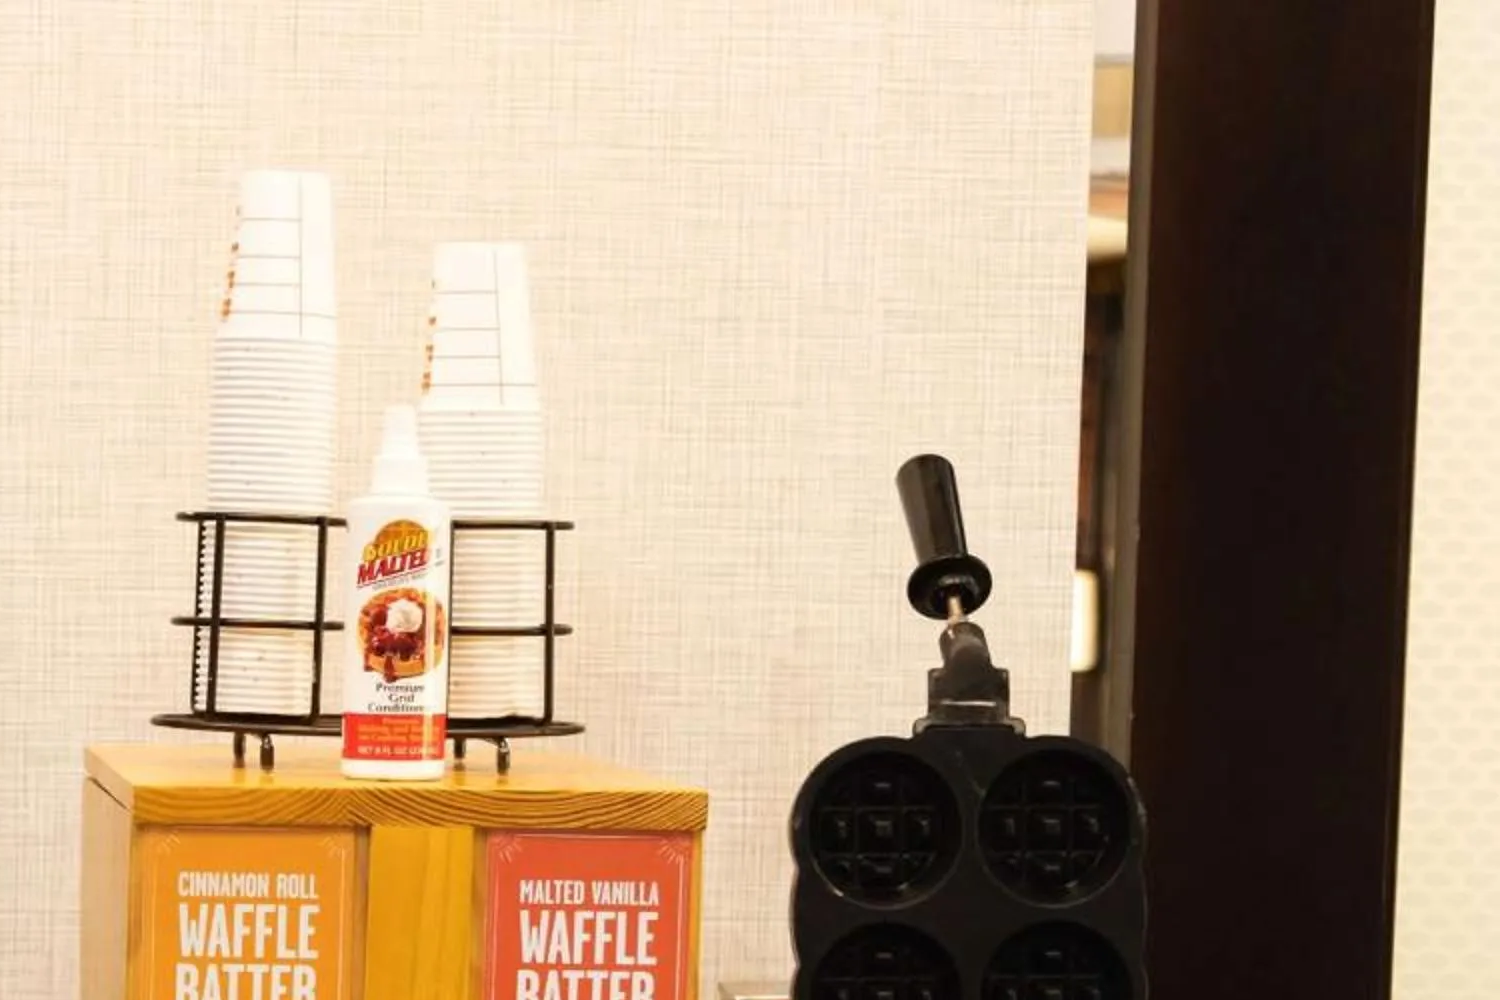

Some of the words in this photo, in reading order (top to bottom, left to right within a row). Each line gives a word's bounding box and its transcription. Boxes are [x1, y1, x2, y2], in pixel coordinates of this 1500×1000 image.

[178, 871, 270, 898] CINNAMON
[276, 873, 319, 899] ROLL
[519, 879, 585, 905] MALTED
[592, 881, 659, 906] VANILLA
[179, 903, 320, 959] WAFFLE
[519, 909, 659, 965] WAFFLE
